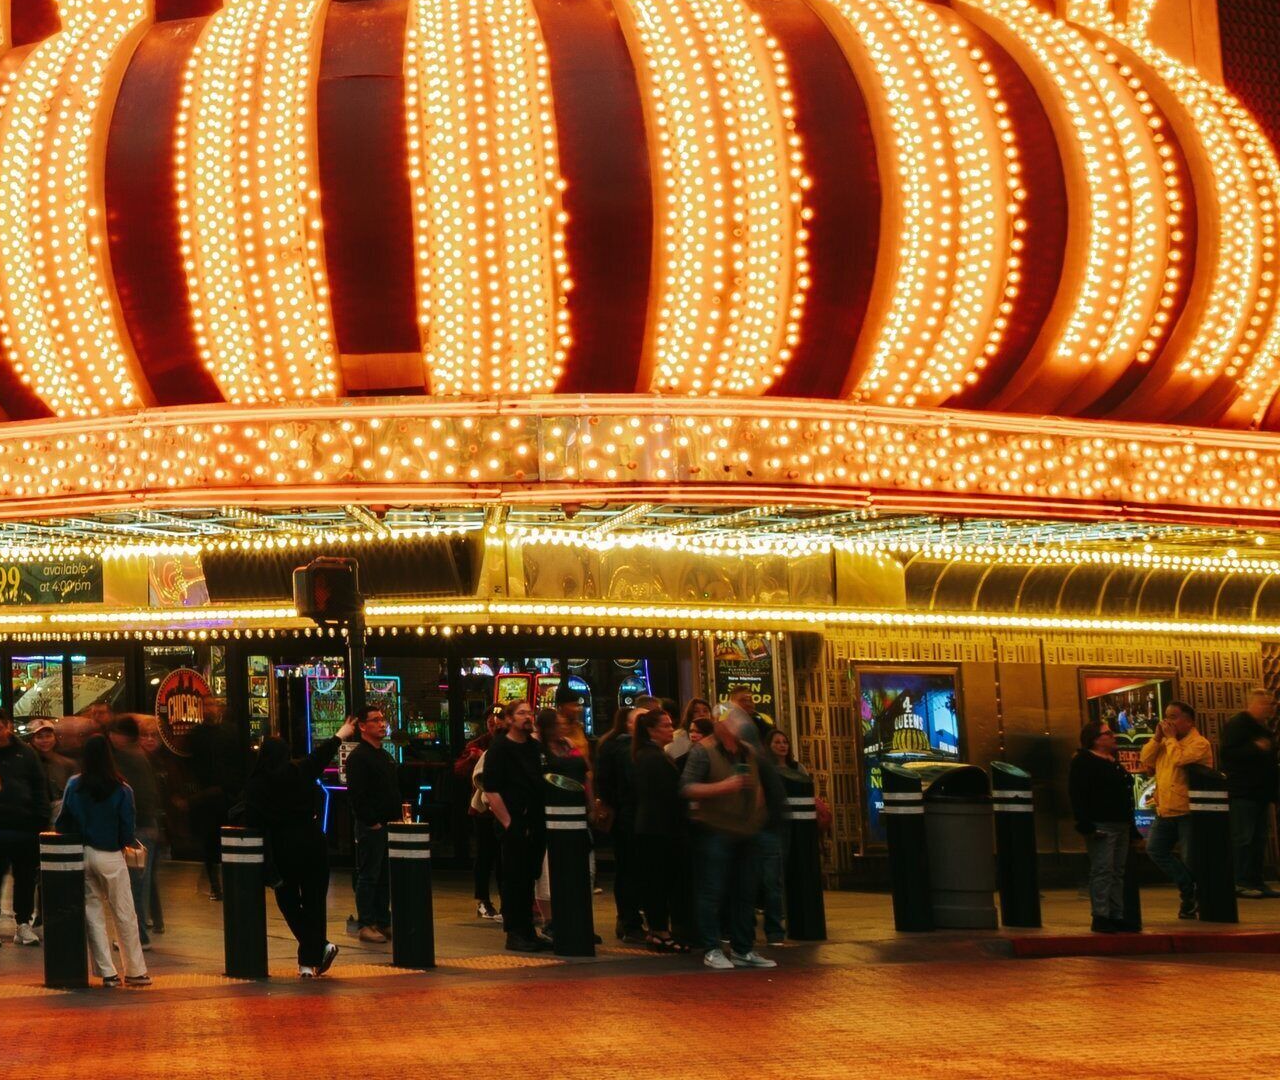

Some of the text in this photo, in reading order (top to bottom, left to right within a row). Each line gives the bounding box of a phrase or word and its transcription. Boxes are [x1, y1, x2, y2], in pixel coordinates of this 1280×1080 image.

[39, 582, 50, 593] at
[74, 581, 91, 594] pm
[728, 683, 761, 693] SN
[902, 696, 913, 713] 4
[894, 713, 924, 731] QUEENS
